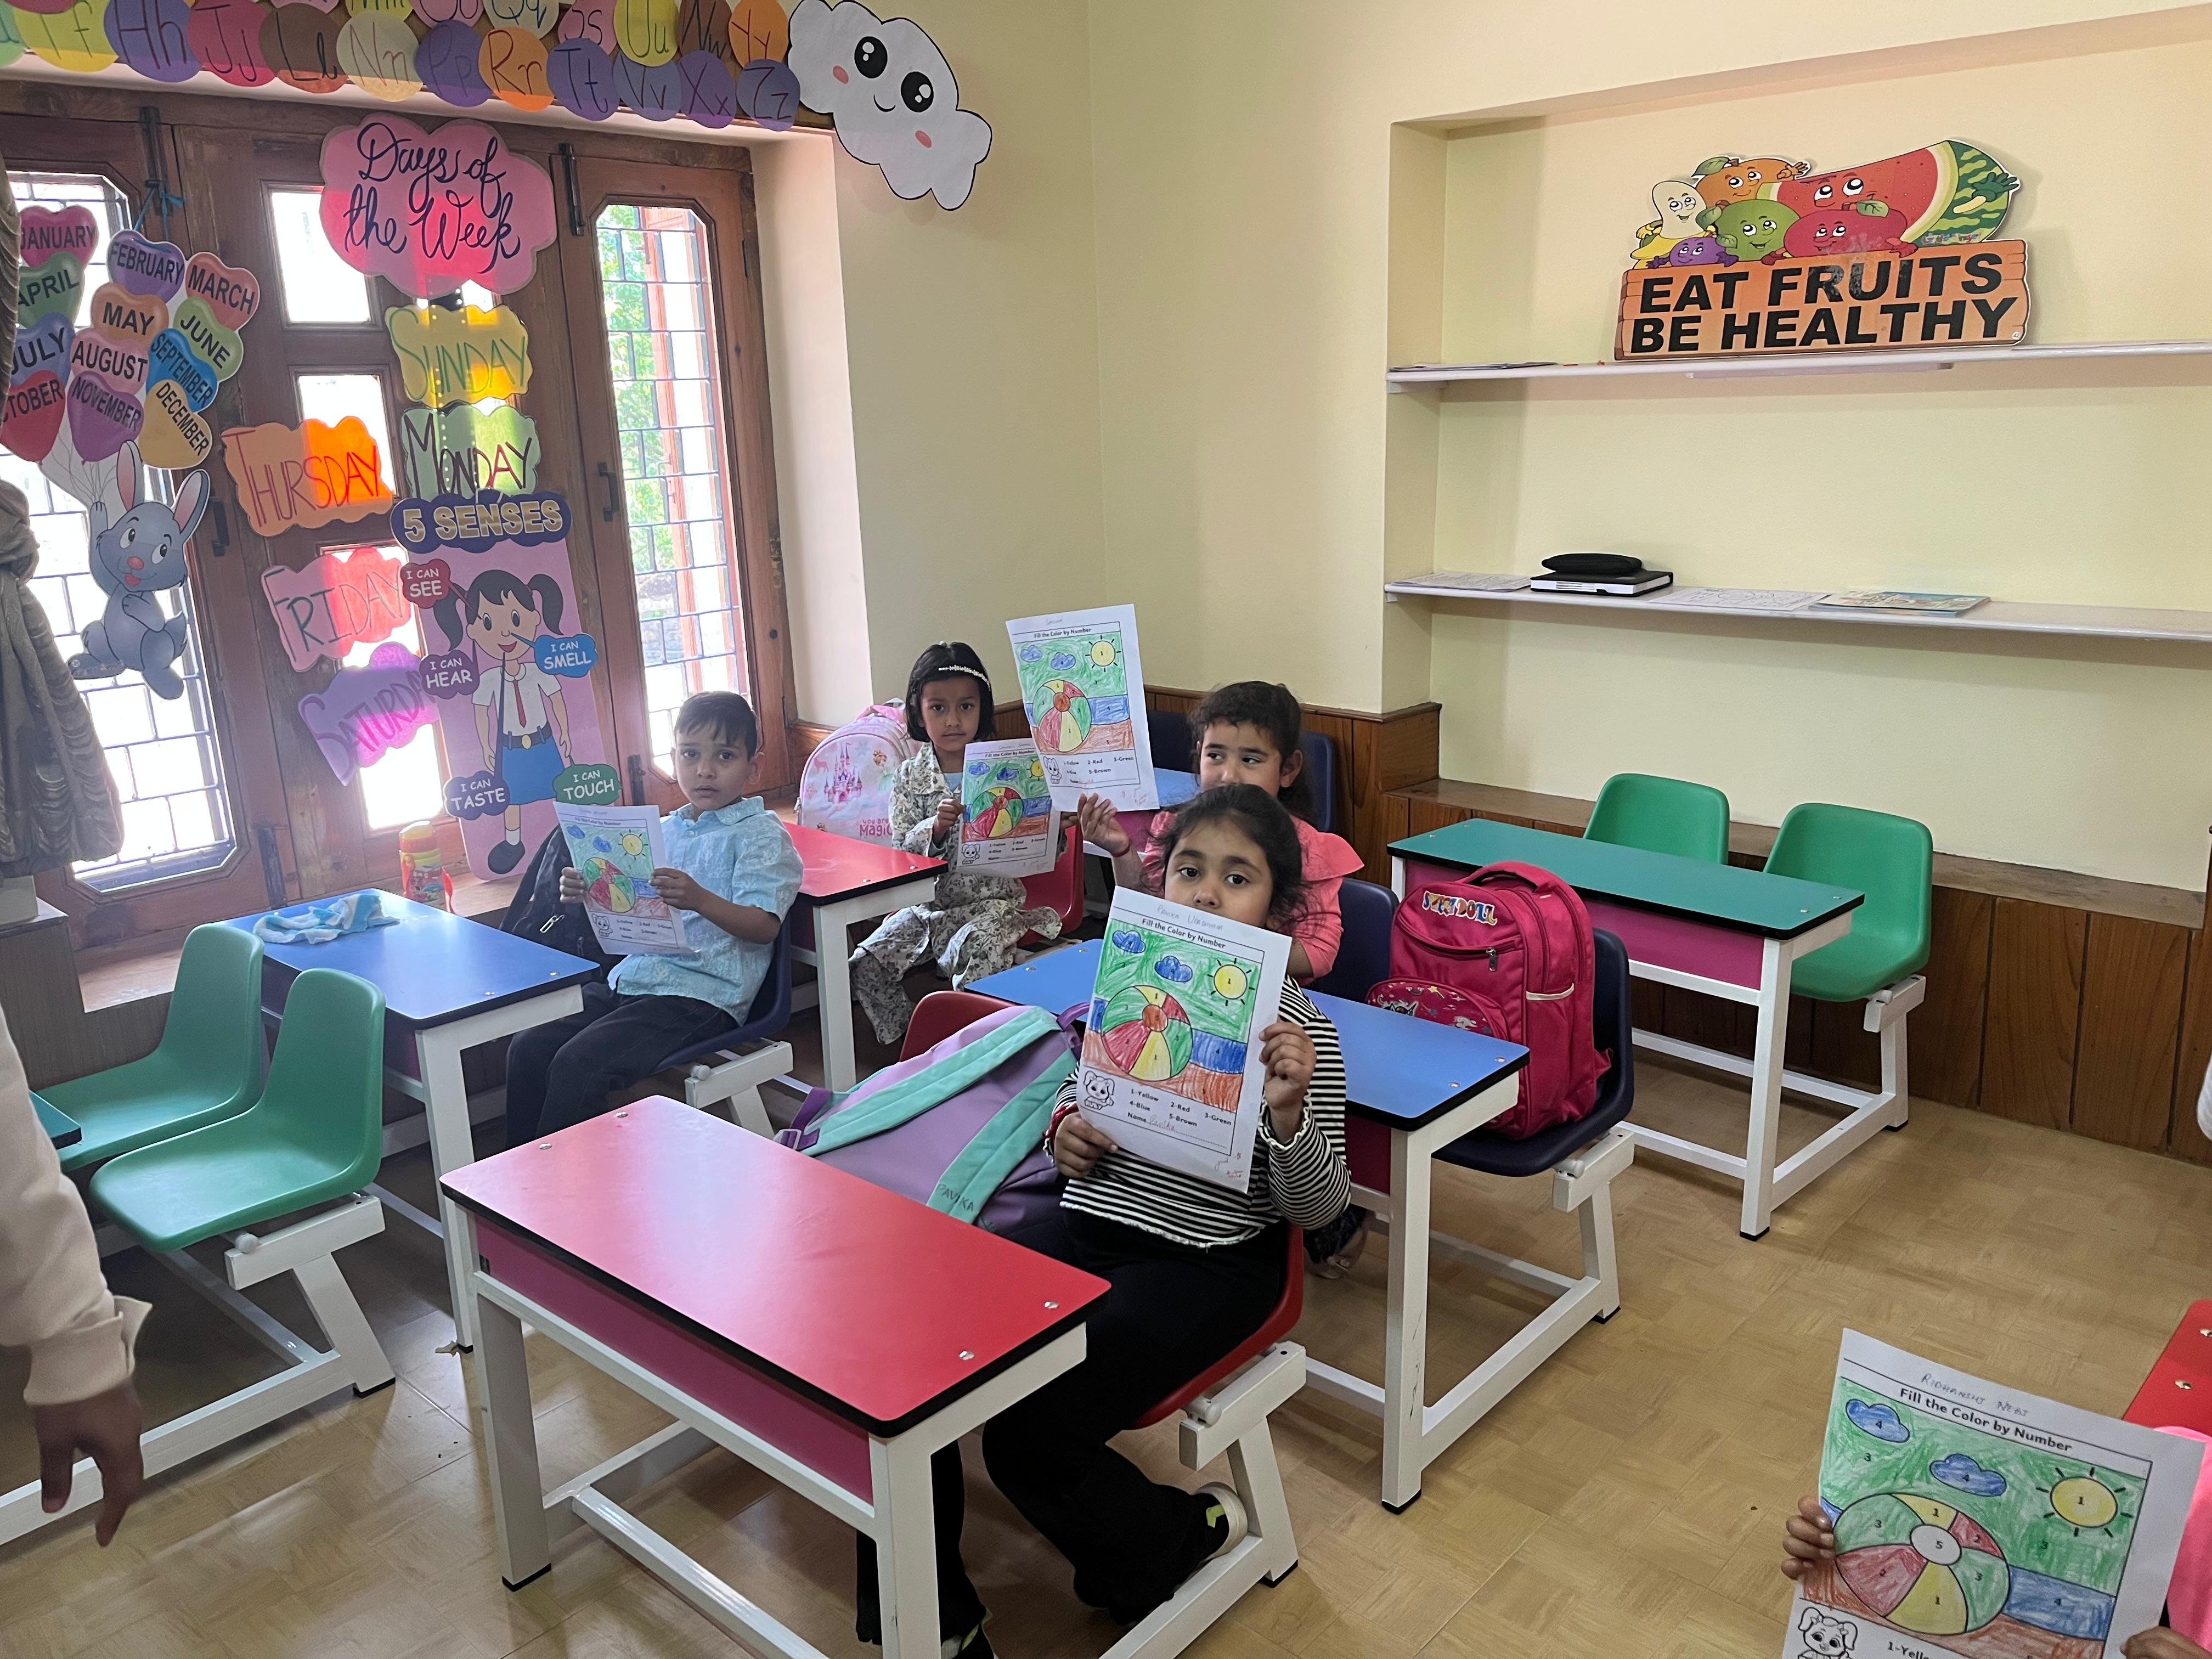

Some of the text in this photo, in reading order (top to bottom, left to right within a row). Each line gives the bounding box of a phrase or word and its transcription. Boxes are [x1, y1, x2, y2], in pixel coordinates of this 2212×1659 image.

[115, 0, 187, 70] Hh
[349, 21, 410, 86] Nn
[488, 30, 542, 95] Rr
[554, 47, 608, 113] Tt
[680, 61, 731, 116] Xx
[743, 66, 792, 119] Zz
[358, 123, 506, 218] Days of
[20, 225, 96, 250] JANUARY
[343, 184, 521, 273] the Week
[111, 241, 185, 285] FEBRUARY
[188, 264, 255, 314] MARCH
[1639, 253, 2002, 314] EAT FRUITS
[103, 302, 155, 335] MAY
[1630, 297, 2018, 354] BE HEALTHY
[11, 327, 64, 375] JULY
[180, 315, 230, 369] JUNE
[390, 308, 526, 400] SUNDAY
[72, 341, 148, 382] AUGUST
[151, 334, 213, 407] SEPTEMBER
[3, 379, 64, 422] TOBER
[72, 377, 141, 432] NOVEMBER
[156, 382, 209, 456] DECEMBER
[404, 413, 532, 498] MONDAY
[221, 430, 380, 527] THURSDAY
[403, 500, 563, 543] 5 SENSES
[406, 568, 439, 579] I CAN
[410, 580, 443, 597] SEE
[264, 566, 403, 662] FRIDAY
[544, 651, 591, 670] SMELL
[560, 640, 579, 651] CAN
[426, 670, 473, 689] HEAR
[430, 657, 462, 670] I CAN
[301, 670, 437, 778] SATURDA
[461, 778, 491, 792] I CAN
[563, 778, 615, 800] TOUCH
[573, 770, 600, 782] I CAN
[450, 787, 506, 811] TASTE
[1142, 918, 1226, 949] Fill the Color by Number
[1127, 1112, 1147, 1123] Name
[1129, 1101, 1198, 1127] 4-Blue 5-Brown
[1131, 1088, 1232, 1126] 1-Yellow 2-Red 3-Green
[1875, 1420, 1883, 1429] 4
[1900, 1388, 2073, 1452] Fill the Color by Number
[1864, 1453, 1871, 1462] 3
[1962, 1474, 1970, 1482] 4
[1933, 1508, 1939, 1517] 1
[2077, 1496, 2084, 1505] 1
[1875, 1519, 1882, 1528] 3
[1973, 1534, 1980, 1543] 2
[1936, 1541, 1943, 1549] 5
[2041, 1541, 2048, 1549] 3
[1975, 1572, 1982, 1581] 3
[1934, 1596, 1940, 1605] 1
[2053, 1598, 2062, 1606] 4
[1888, 1641, 1929, 1659] 1-Yell
